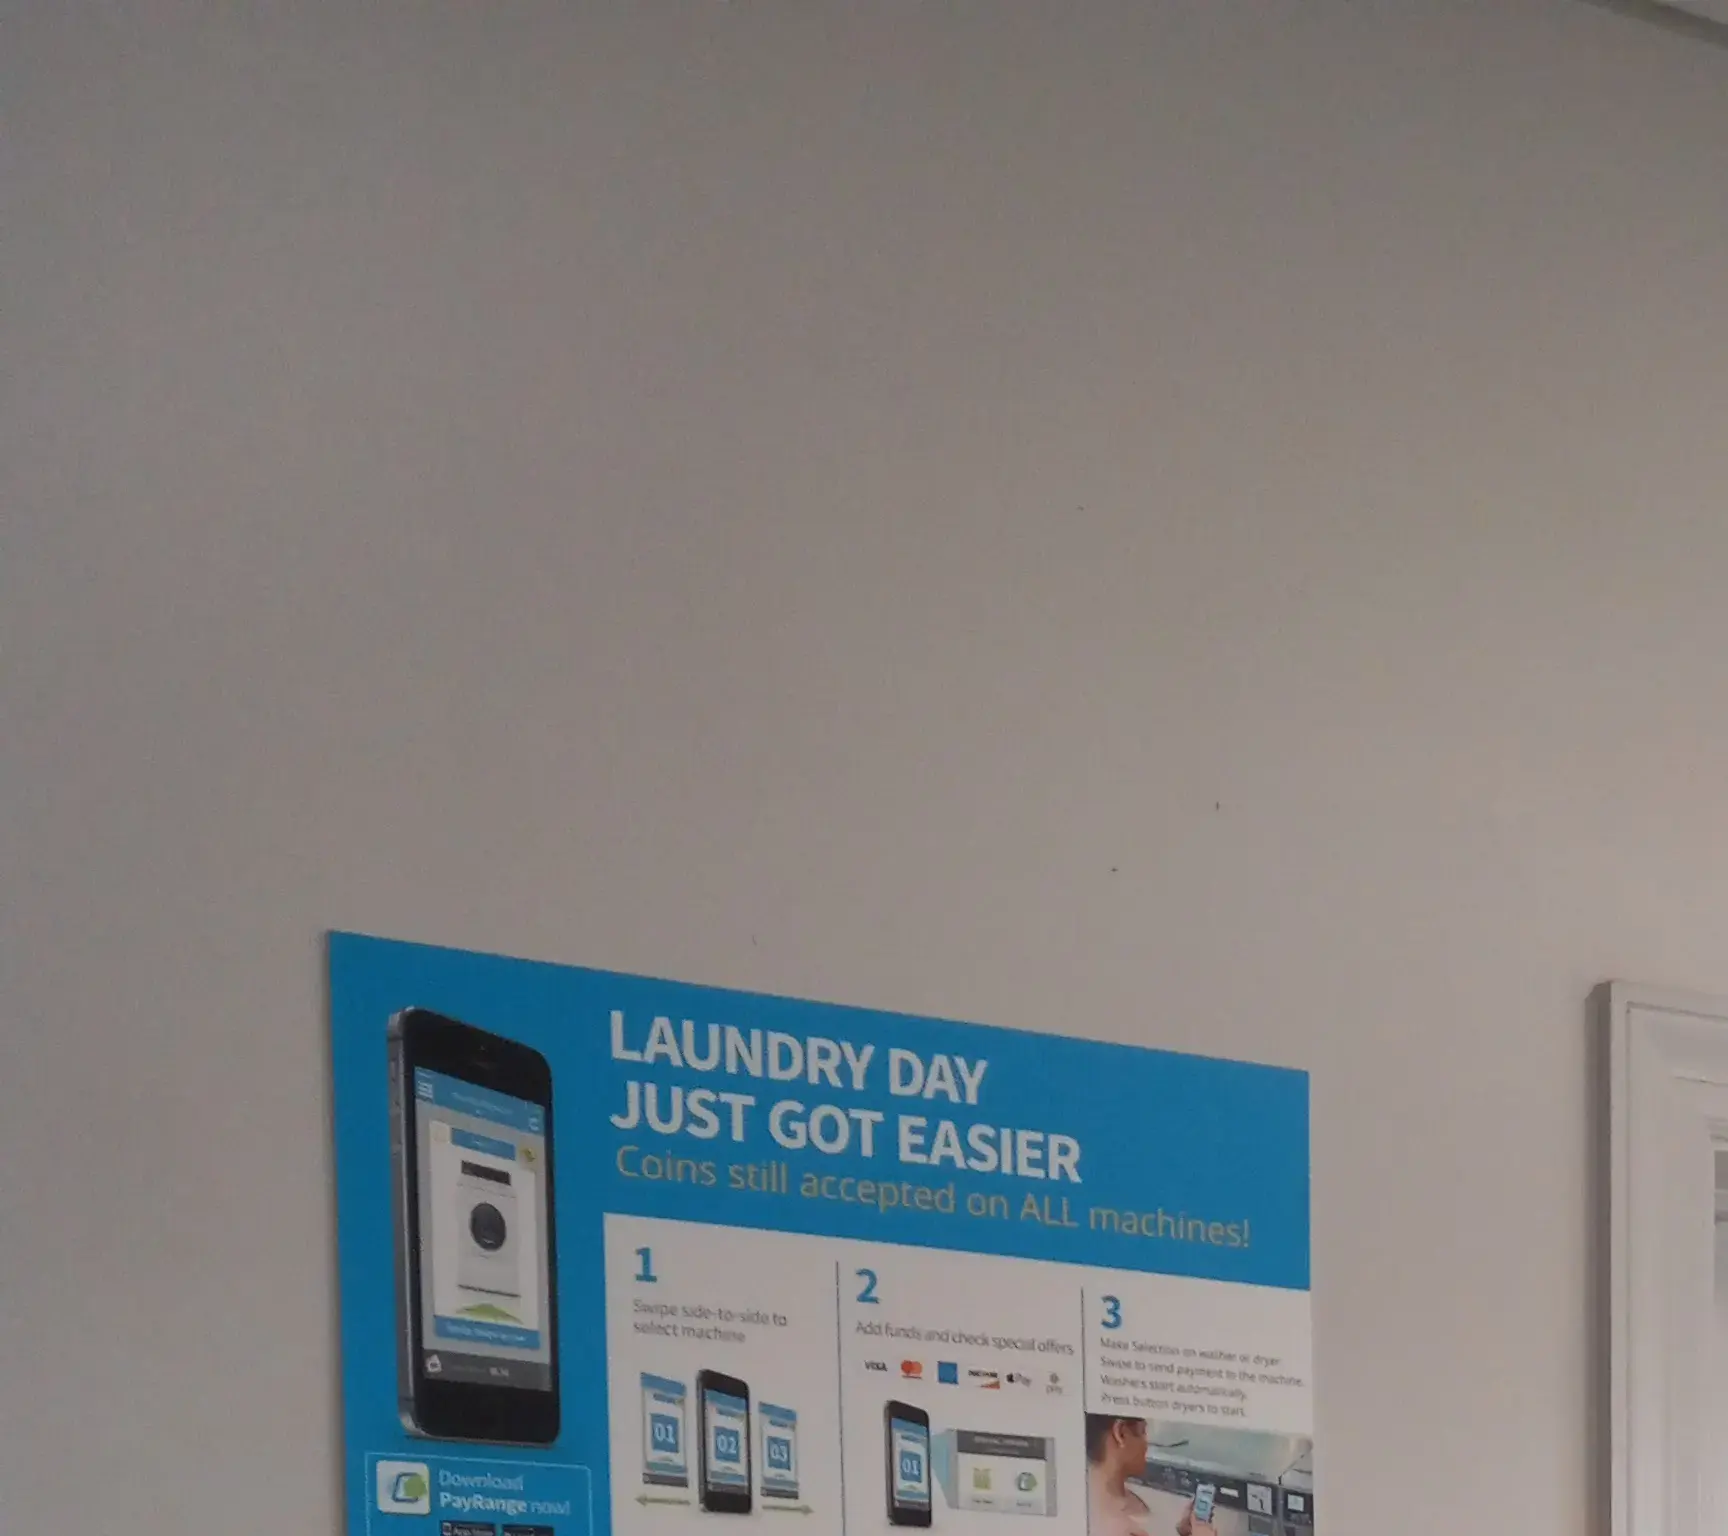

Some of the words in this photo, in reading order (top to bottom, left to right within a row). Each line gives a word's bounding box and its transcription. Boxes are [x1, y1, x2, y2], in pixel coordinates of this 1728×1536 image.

[610, 1010, 876, 1090] LAUNDRY
[888, 1047, 987, 1105] DAY
[609, 1081, 755, 1143] JUST
[768, 1097, 884, 1158] GOT
[899, 1115, 1082, 1183] EASIER
[616, 1145, 718, 1186] Coins
[729, 1158, 789, 1195] still
[802, 1168, 955, 1214] accepted
[967, 1191, 1009, 1220] on
[1020, 1192, 1079, 1228] ALL
[1089, 1203, 1250, 1248] machines!
[634, 1247, 658, 1283] 1
[855, 1267, 880, 1304] 2
[633, 1299, 677, 1319] Swipe
[773, 1313, 787, 1327] to
[1101, 1295, 1123, 1329] 3
[855, 1320, 882, 1336] Add
[885, 1322, 922, 1341] funds
[924, 1327, 949, 1343] and
[952, 1328, 990, 1348] check
[992, 1334, 1035, 1352] special
[1037, 1338, 1075, 1356] offers
[653, 1422, 676, 1445] 01
[716, 1434, 738, 1455] 02
[770, 1444, 788, 1463] 03
[438, 1469, 524, 1491] Download
[440, 1491, 528, 1516] PayRange
